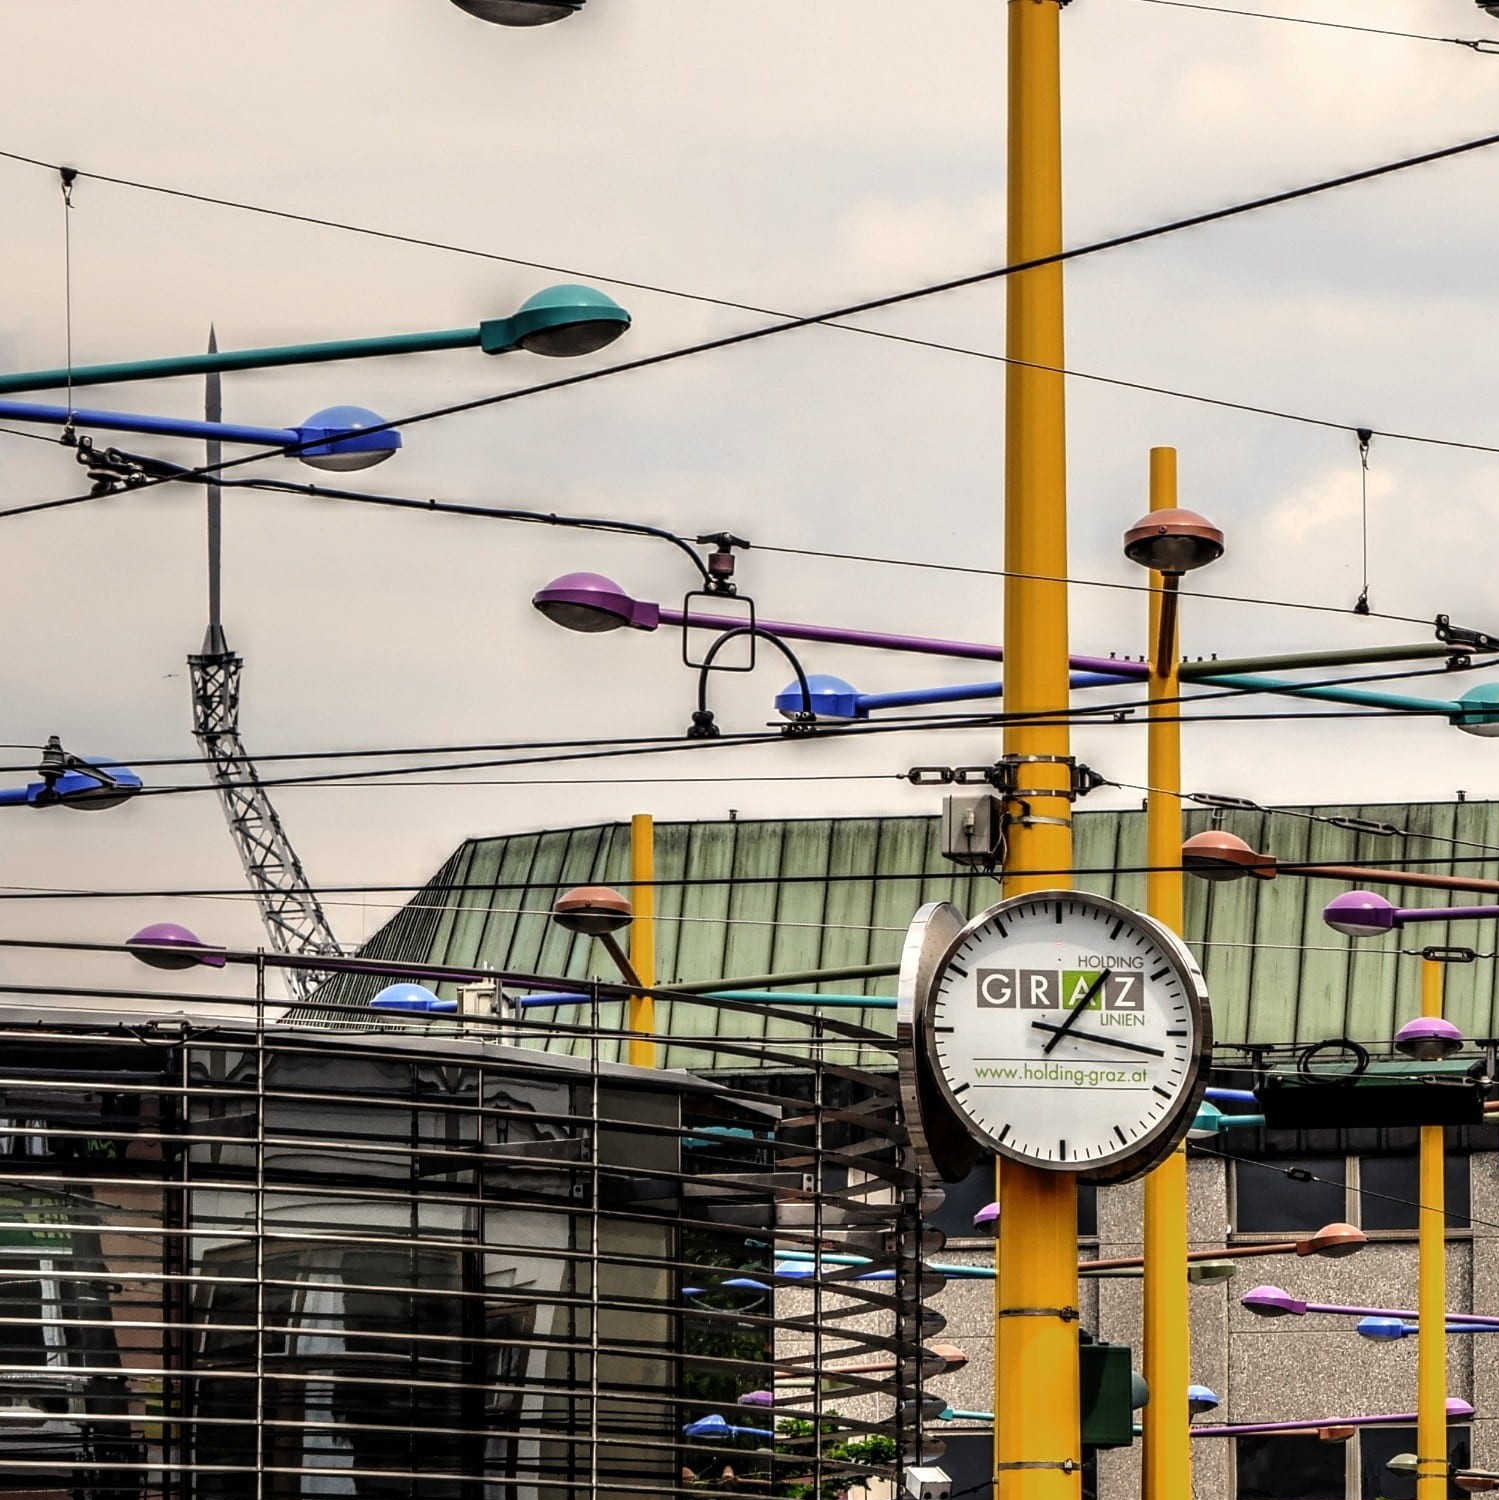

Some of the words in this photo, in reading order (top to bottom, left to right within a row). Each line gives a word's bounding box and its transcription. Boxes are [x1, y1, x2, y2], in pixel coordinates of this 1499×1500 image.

[1078, 955, 1144, 968] HOLDING
[979, 971, 1141, 1009] GRAZ
[1100, 1014, 1145, 1027] LINIEN
[975, 1063, 1147, 1085] www.holding-graz.at
